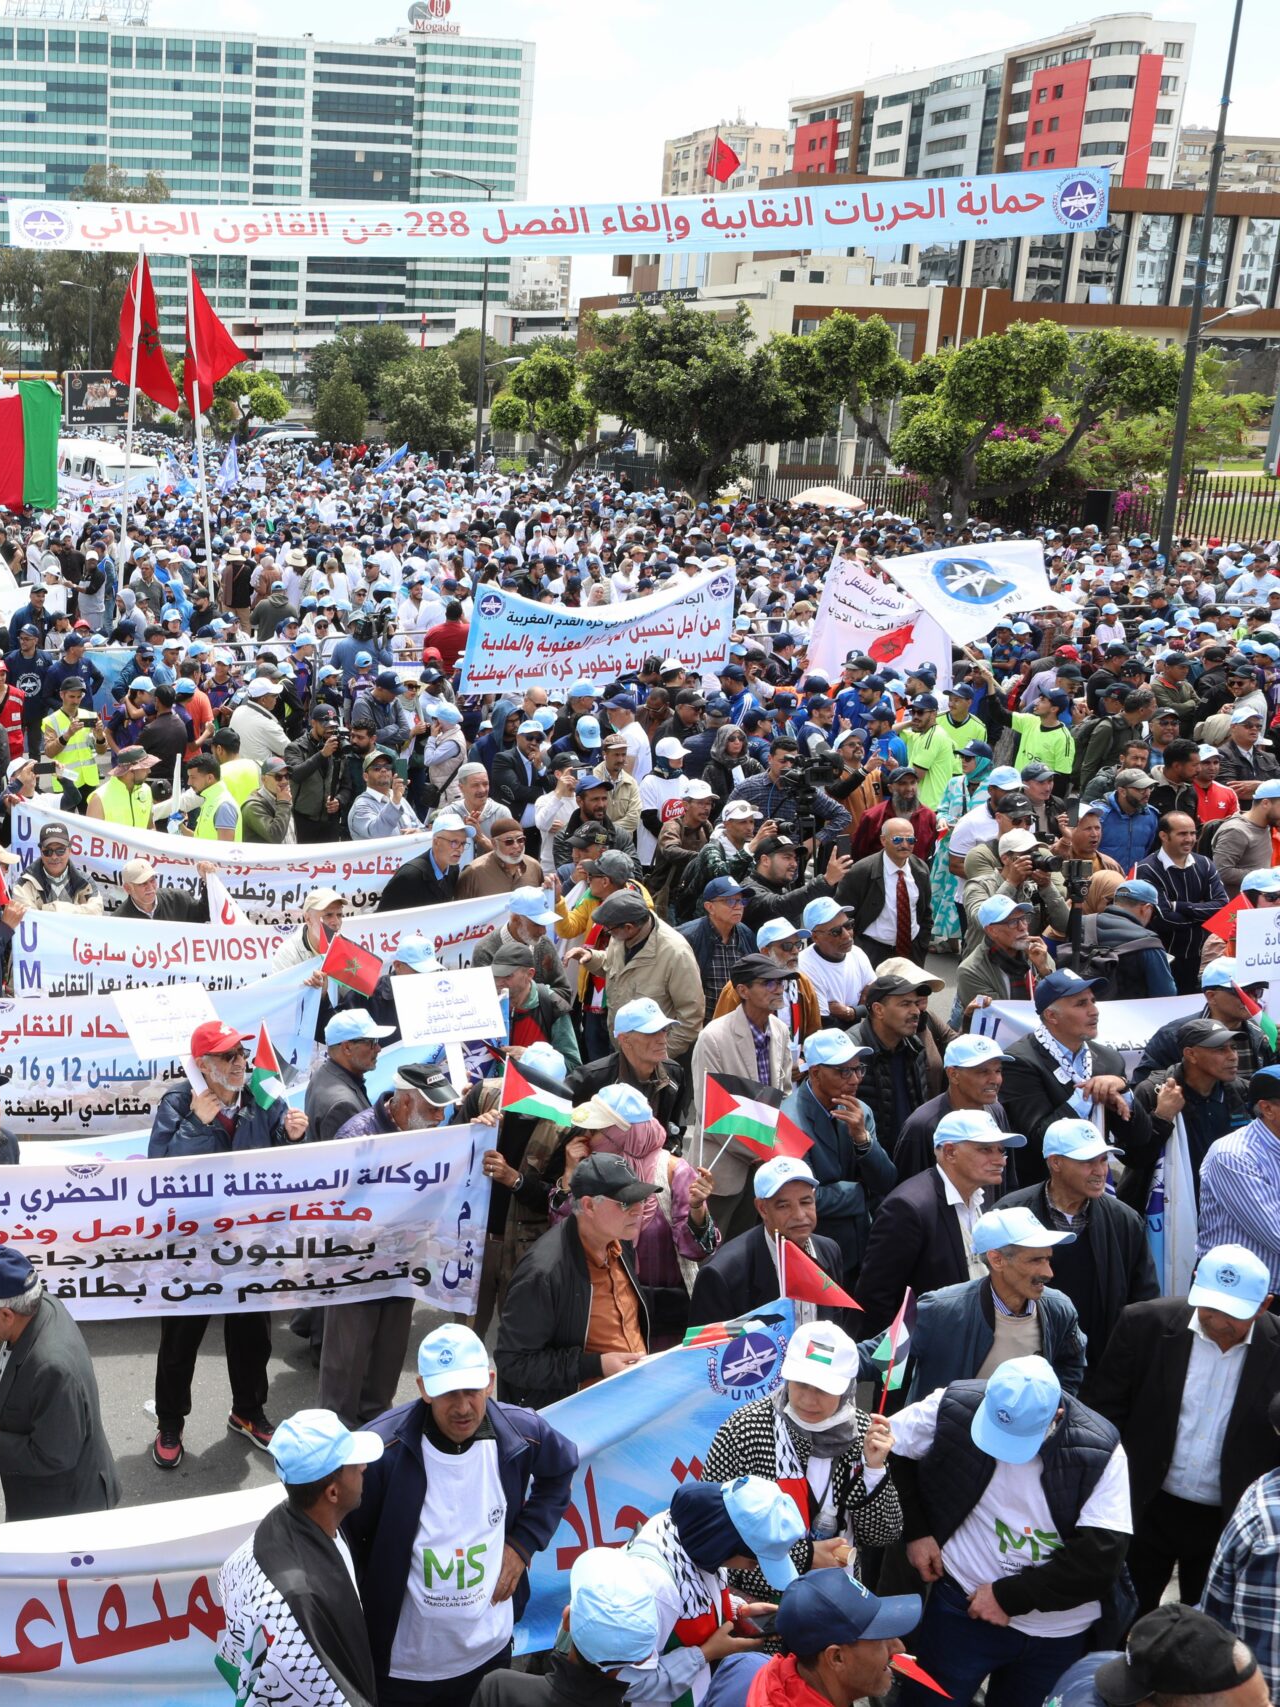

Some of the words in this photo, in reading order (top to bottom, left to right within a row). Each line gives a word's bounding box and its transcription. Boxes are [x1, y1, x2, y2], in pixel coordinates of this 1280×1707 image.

[415, 19, 460, 33] Mogador
[824, 188, 946, 233] الحريات
[957, 181, 1045, 225] حماية
[80, 207, 201, 246] الجنائي
[214, 211, 329, 245] القانون
[405, 210, 470, 237] 288
[483, 206, 588, 245] الفصل
[602, 202, 691, 244] وإلغاء
[701, 196, 814, 238] النقابية
[342, 219, 395, 245] من
[507, 611, 553, 627] المغربية
[628, 618, 674, 643] تحسين
[677, 609, 700, 639] أجل
[700, 616, 720, 637] من
[481, 633, 534, 657] والمادية
[467, 664, 516, 687] الوطنية
[515, 661, 548, 687] القدم
[578, 654, 621, 680] وتطوير
[664, 805, 686, 818] bimo
[70, 834, 129, 861] S.B.M
[134, 852, 195, 867] المغرب
[287, 860, 337, 879] شركة
[342, 855, 403, 881] تقاعدو
[193, 937, 284, 962] EVIOSYS
[434, 922, 495, 952] متقاعدو
[48, 973, 94, 998] التقاعد
[97, 976, 122, 997] بعد
[20, 1056, 39, 1082] 16
[45, 1067, 54, 1088] و
[61, 1057, 82, 1082] 12
[87, 1059, 157, 1089] الفصلين
[4, 1099, 71, 1121] الوظيفة
[78, 1098, 150, 1127] متقاعدي
[223, 1168, 349, 1197] المستقلة
[356, 1161, 450, 1192] الوكالة
[21, 1177, 127, 1221] الحضري
[137, 1173, 213, 1207] للنقل
[74, 1207, 199, 1243] وأرامل
[214, 1200, 372, 1233] متقاعدو
[211, 1236, 376, 1267] يطالبون
[43, 1274, 147, 1300] بطاق
[161, 1276, 224, 1302] من
[238, 1262, 432, 1303] وتمكينهم
[731, 1384, 766, 1401] UMT
